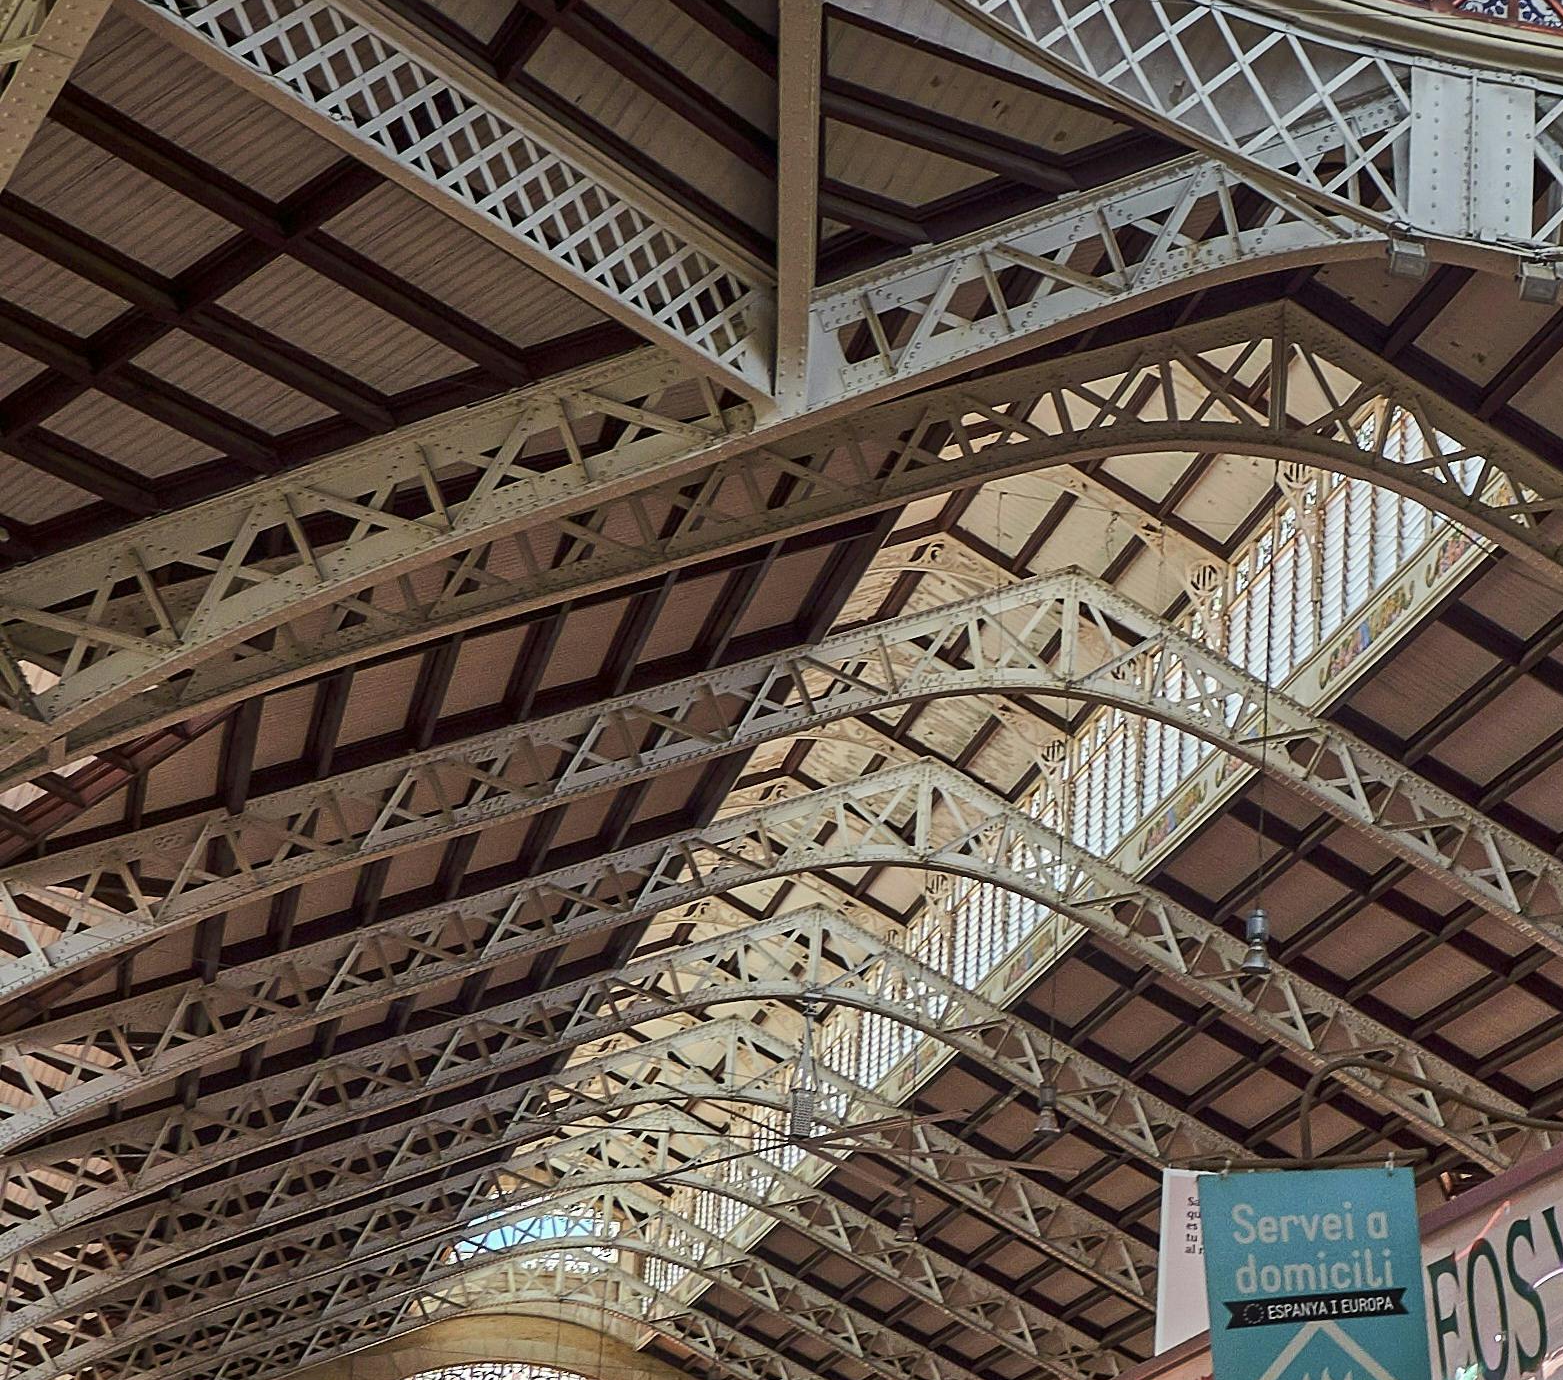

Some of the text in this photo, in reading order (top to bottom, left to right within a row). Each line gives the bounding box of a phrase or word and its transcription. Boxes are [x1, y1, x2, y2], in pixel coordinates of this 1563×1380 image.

[1231, 1201, 1393, 1245] Servei a
[1235, 1247, 1394, 1294] domicili
[1267, 1296, 1394, 1320] ESPANYA I EUROPA
